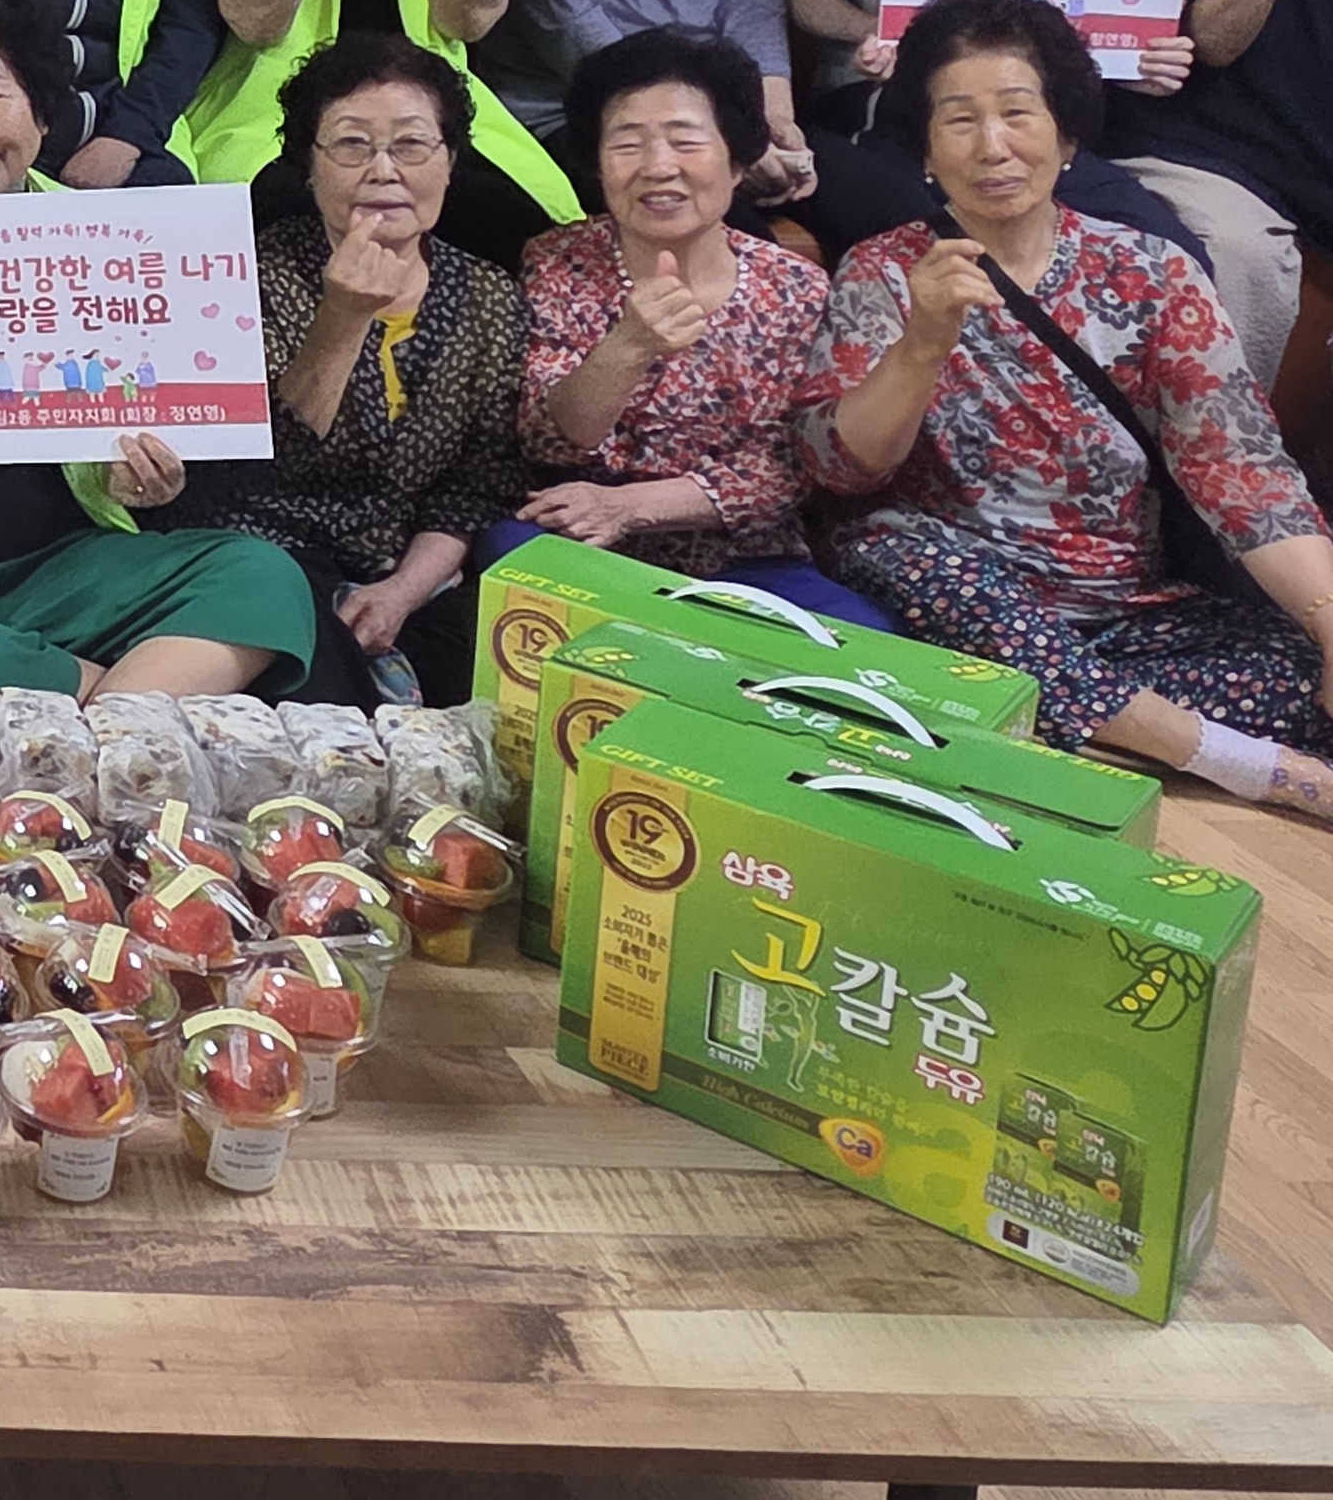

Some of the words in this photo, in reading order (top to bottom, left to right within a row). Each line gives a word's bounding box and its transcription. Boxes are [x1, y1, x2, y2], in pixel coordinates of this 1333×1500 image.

[16, 225, 42, 241] 활력
[104, 251, 167, 290] 여름
[180, 252, 248, 282] 나기
[71, 293, 172, 333] 전해요
[36, 407, 116, 426] 주민자치회
[498, 567, 555, 588] GIFT
[552, 583, 601, 602] SET
[519, 622, 553, 652] 19
[601, 743, 668, 768] GIFT
[667, 766, 724, 788] SET
[626, 808, 669, 845] 19
[722, 851, 795, 900] 삼육
[603, 916, 644, 943] 소비자가
[621, 904, 653, 927] 2025
[731, 897, 997, 1067] 고칼슘
[913, 1054, 985, 1104] 두유
[836, 1126, 873, 1158] Ca
